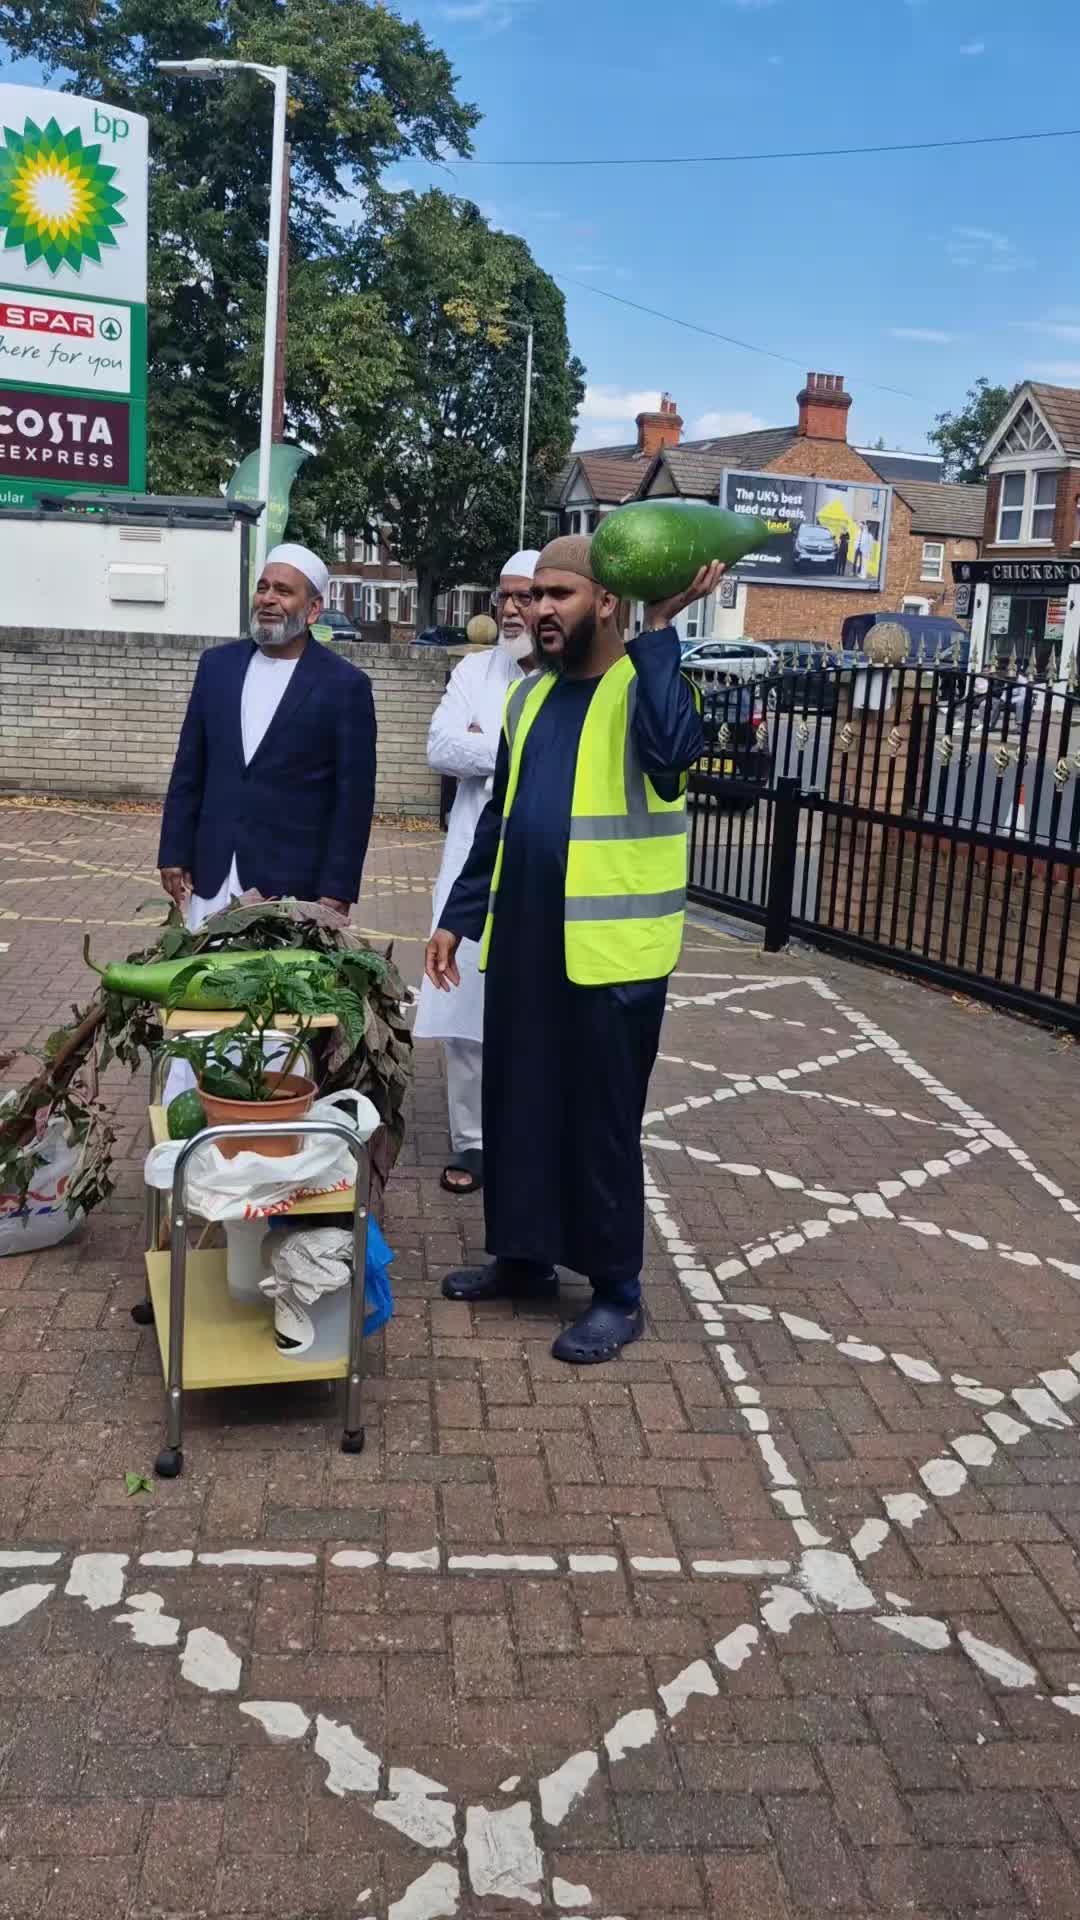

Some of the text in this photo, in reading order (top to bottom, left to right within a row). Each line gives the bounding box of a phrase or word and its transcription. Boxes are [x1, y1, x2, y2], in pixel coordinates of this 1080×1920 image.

[94, 107, 129, 143] bp
[6, 307, 92, 334] SPAR
[48, 343, 82, 368] for
[88, 355, 122, 376] you
[0, 490, 24, 504] ular
[735, 488, 802, 504] The UK's best
[734, 504, 806, 520] used car deals,
[992, 564, 1065, 580] CHICKEN
